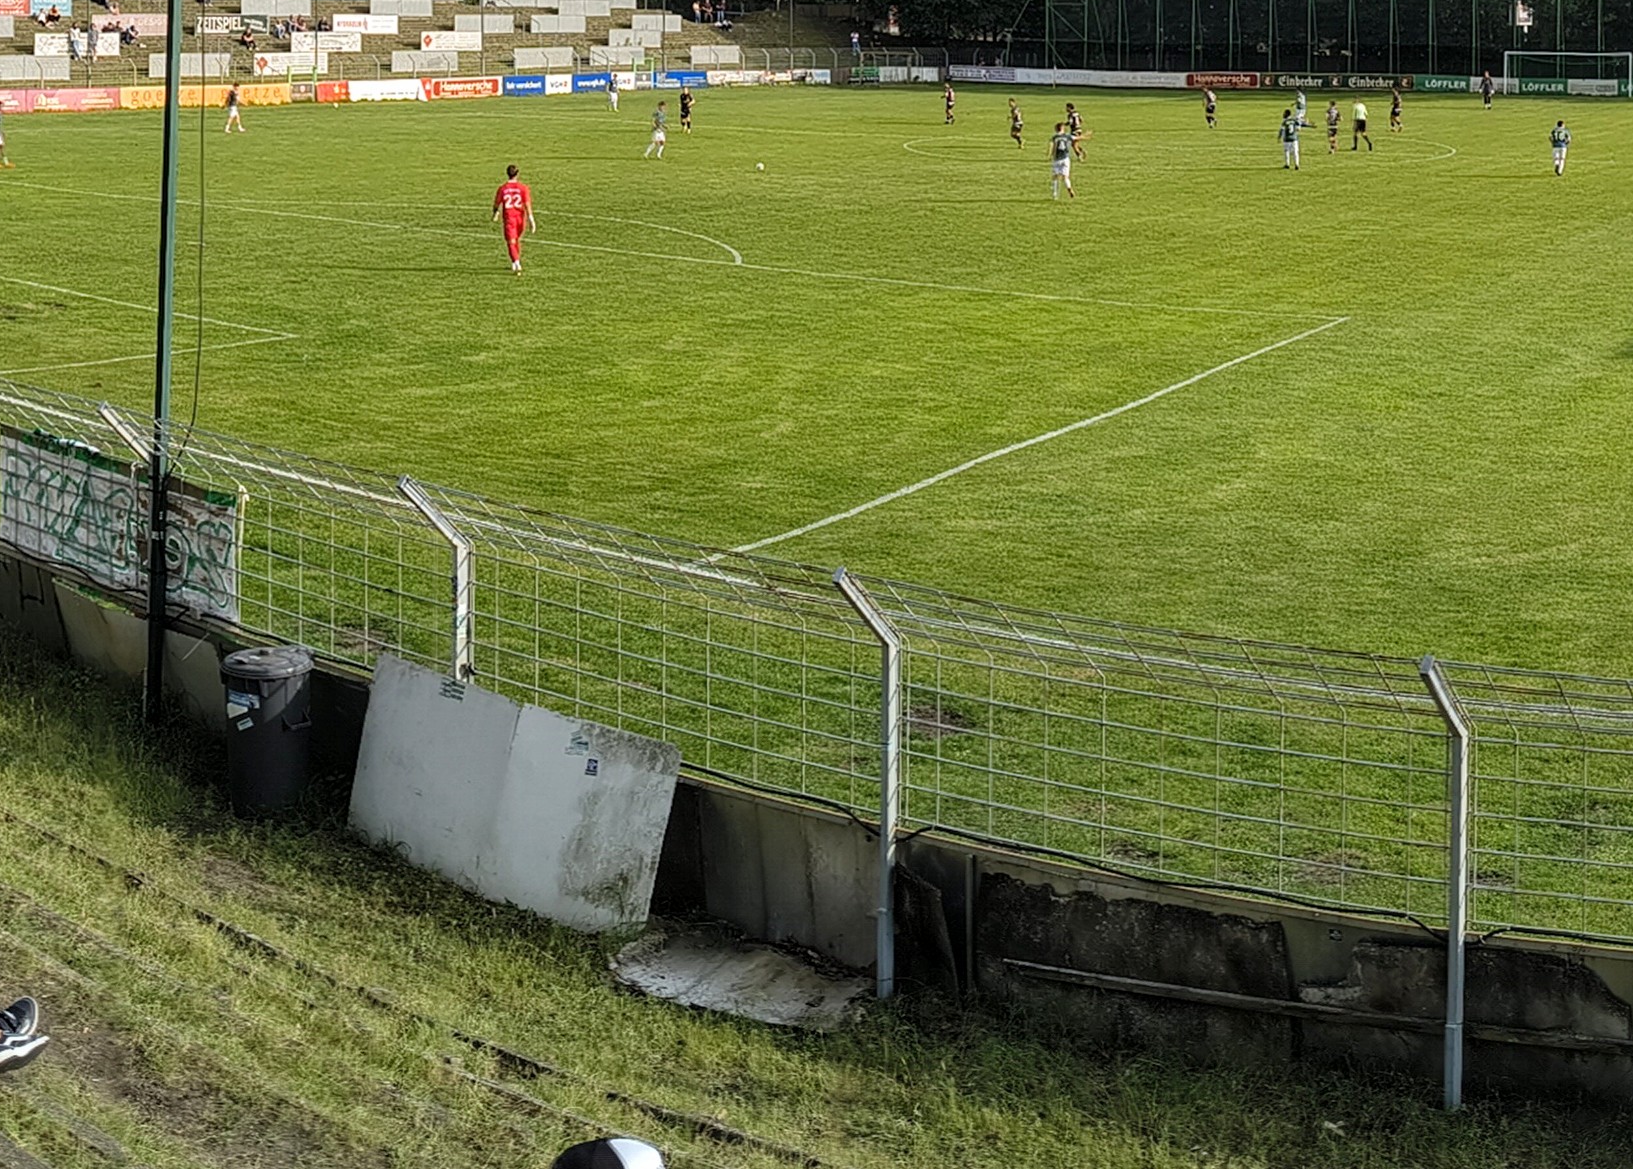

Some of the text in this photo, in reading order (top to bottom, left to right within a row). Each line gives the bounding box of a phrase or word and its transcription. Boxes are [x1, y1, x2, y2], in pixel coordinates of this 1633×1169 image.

[1278, 75, 1323, 87] Einbecker
[1348, 75, 1394, 88] Einbecker
[503, 194, 523, 210] 22
